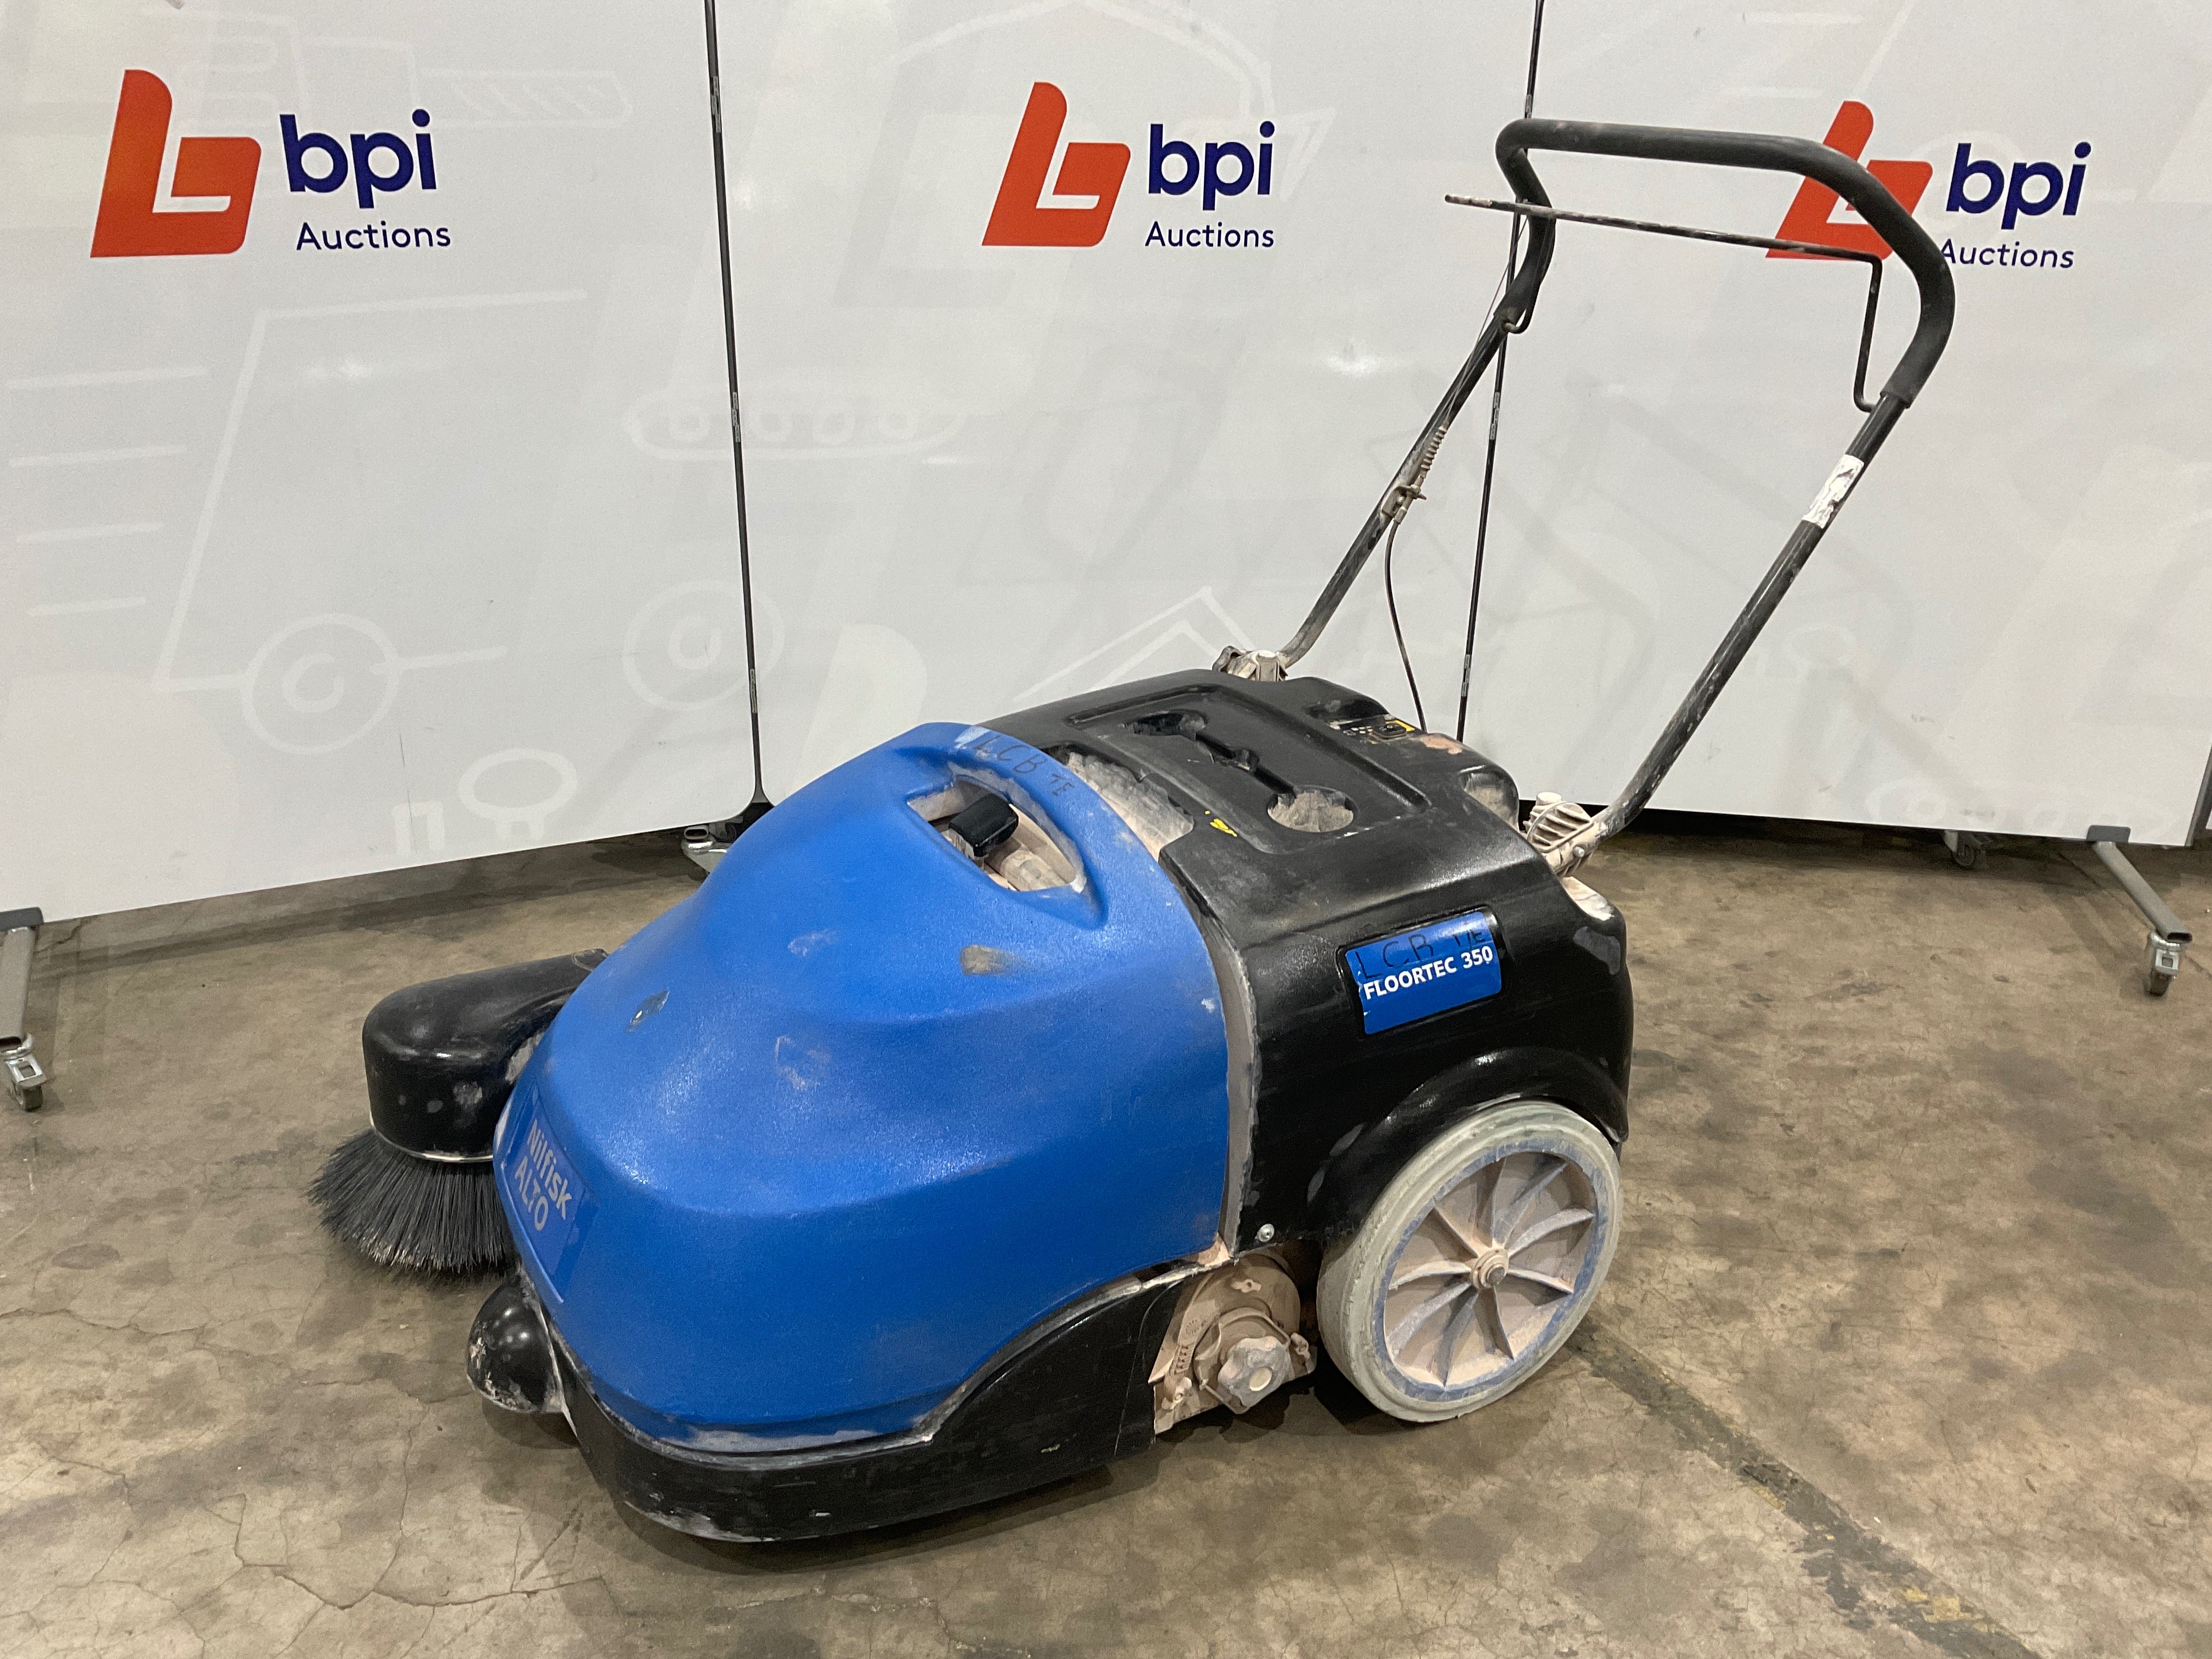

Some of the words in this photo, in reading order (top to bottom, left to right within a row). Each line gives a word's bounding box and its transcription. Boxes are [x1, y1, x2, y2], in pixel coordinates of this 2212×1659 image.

[280, 109, 436, 209] bpi
[1148, 121, 1275, 211] bpi
[1946, 142, 2091, 230] bpi
[296, 221, 450, 251] Auctions
[1145, 222, 1274, 248] Auctions
[1942, 239, 2074, 268] Auctions
[1363, 957, 1457, 1000] FLOORTEC
[1461, 946, 1493, 969] 350
[514, 1155, 549, 1231] ALTO
[527, 1118, 572, 1220] Nilfisk
